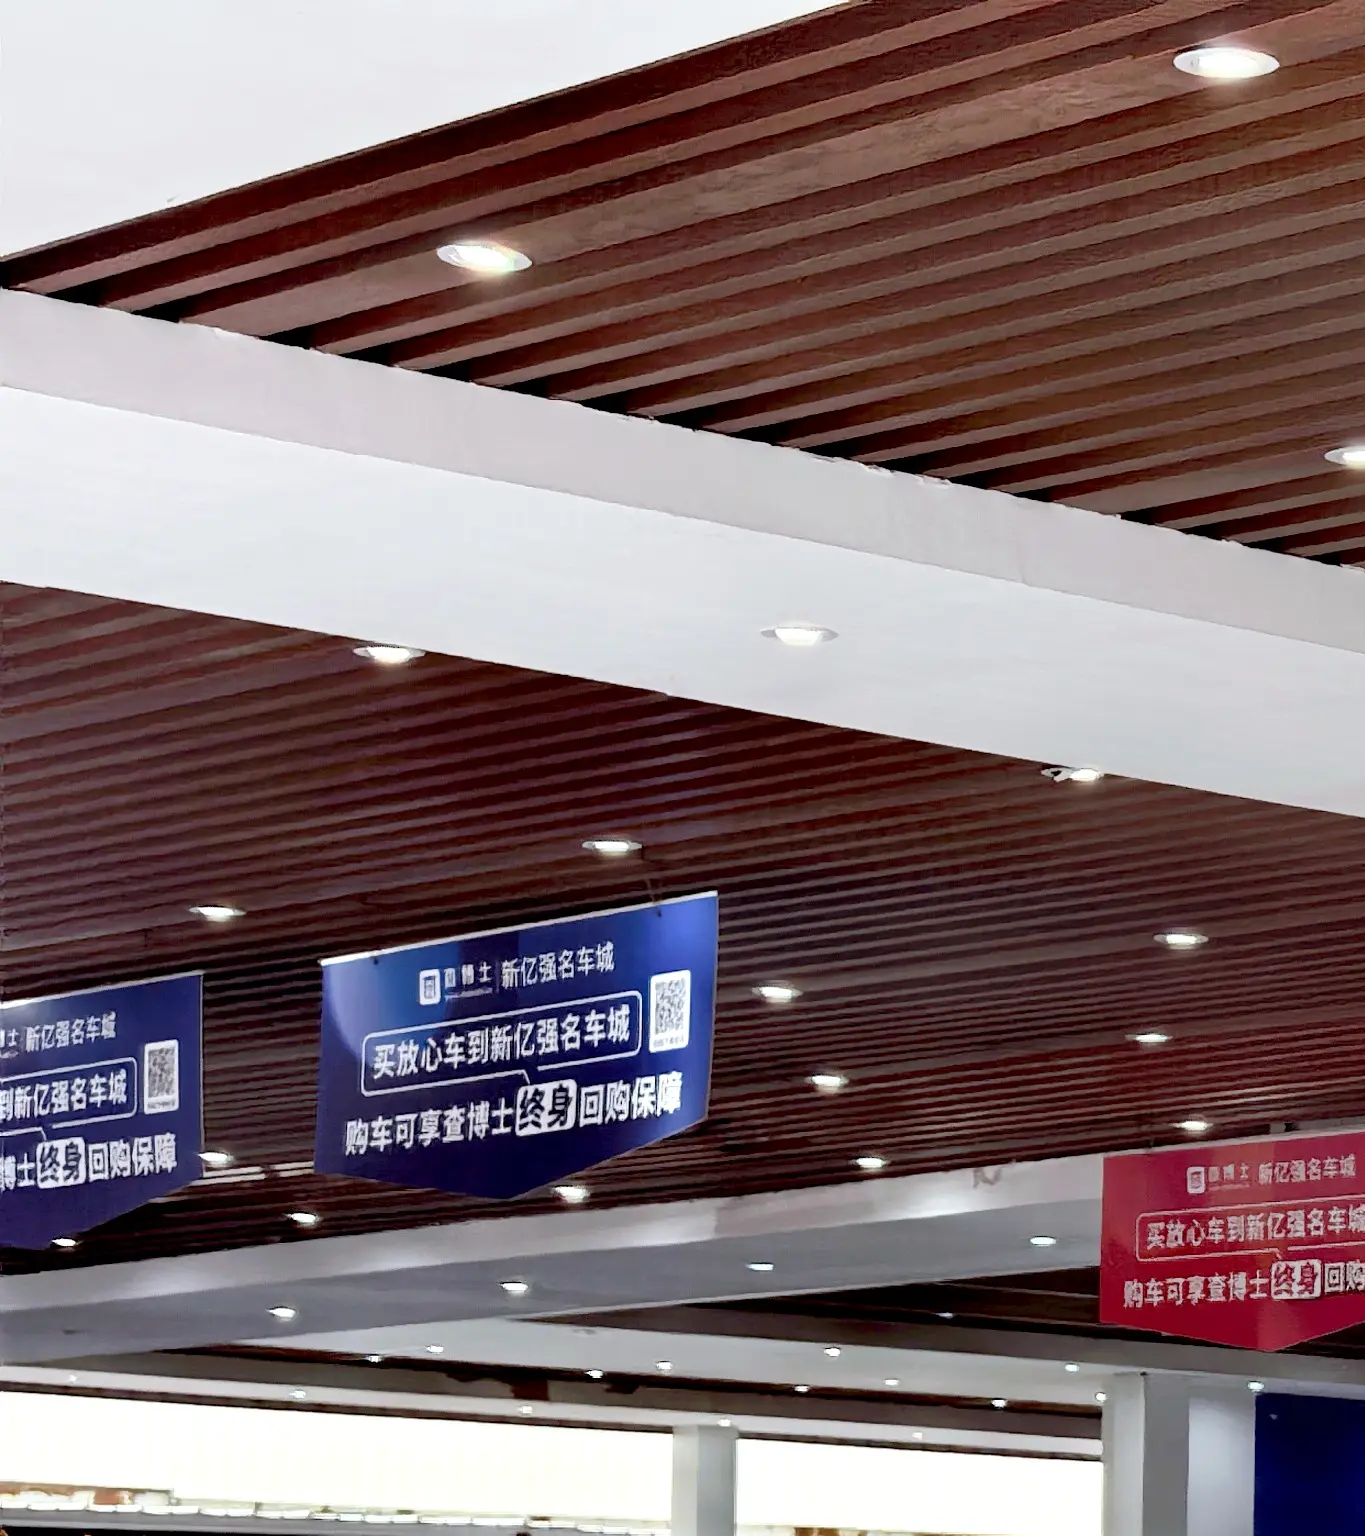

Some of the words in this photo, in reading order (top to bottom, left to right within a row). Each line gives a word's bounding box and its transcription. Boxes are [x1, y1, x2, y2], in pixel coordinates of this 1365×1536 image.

[501, 940, 615, 989] 新亿强名车城
[25, 1011, 117, 1052] 新亿强名车城
[372, 1004, 631, 1080] 买放心车到新亿强名车城
[344, 1070, 684, 1156] 购车可享查博士终身回购保障
[1258, 1153, 1357, 1186] 新亿强名车城
